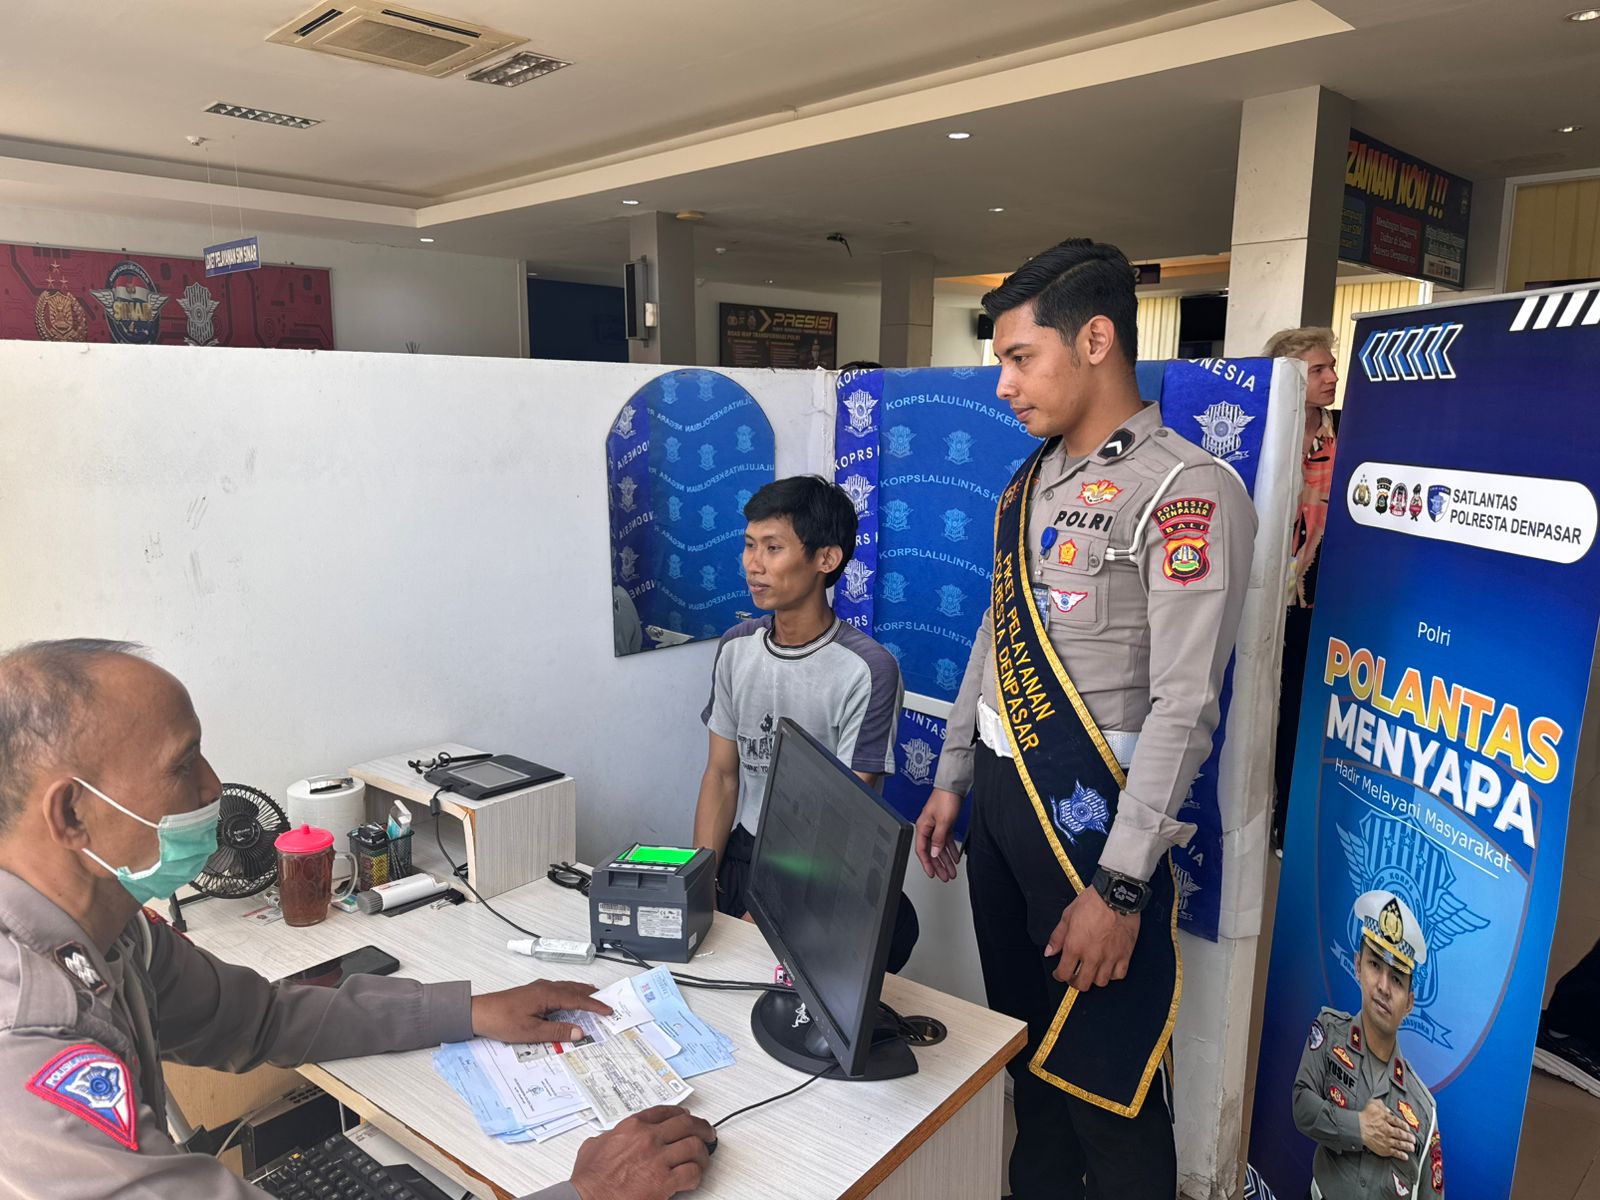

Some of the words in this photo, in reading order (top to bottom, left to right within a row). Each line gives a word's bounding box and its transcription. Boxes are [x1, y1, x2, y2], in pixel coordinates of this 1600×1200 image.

[1345, 140, 1398, 201] ZAMAN
[1396, 163, 1430, 211] NOW
[773, 312, 833, 330] PRESISI
[836, 369, 877, 390] KOPR
[1188, 359, 1256, 393] NESIA
[1156, 501, 1210, 517] POLRESTA
[1452, 488, 1518, 511] SATLANTAS
[1054, 510, 1113, 533] POLRI
[1159, 507, 1208, 522] DENPASAR
[1164, 523, 1206, 534] BALI
[1449, 509, 1509, 532] POLRESTA
[1510, 520, 1582, 545] DENPASAR
[1417, 621, 1452, 647] Polri
[1006, 606, 1056, 723] PELAYANAN
[996, 647, 1040, 752] DENPASAR
[1324, 636, 1563, 784] POLANTAS
[1326, 694, 1536, 850] MENYAPA
[1334, 757, 1361, 788] Hadir
[1361, 774, 1421, 820] Melayani
[1424, 805, 1513, 873] Masyarakat
[1389, 872, 1415, 892] KORPS
[1327, 1056, 1356, 1089] YUSUF
